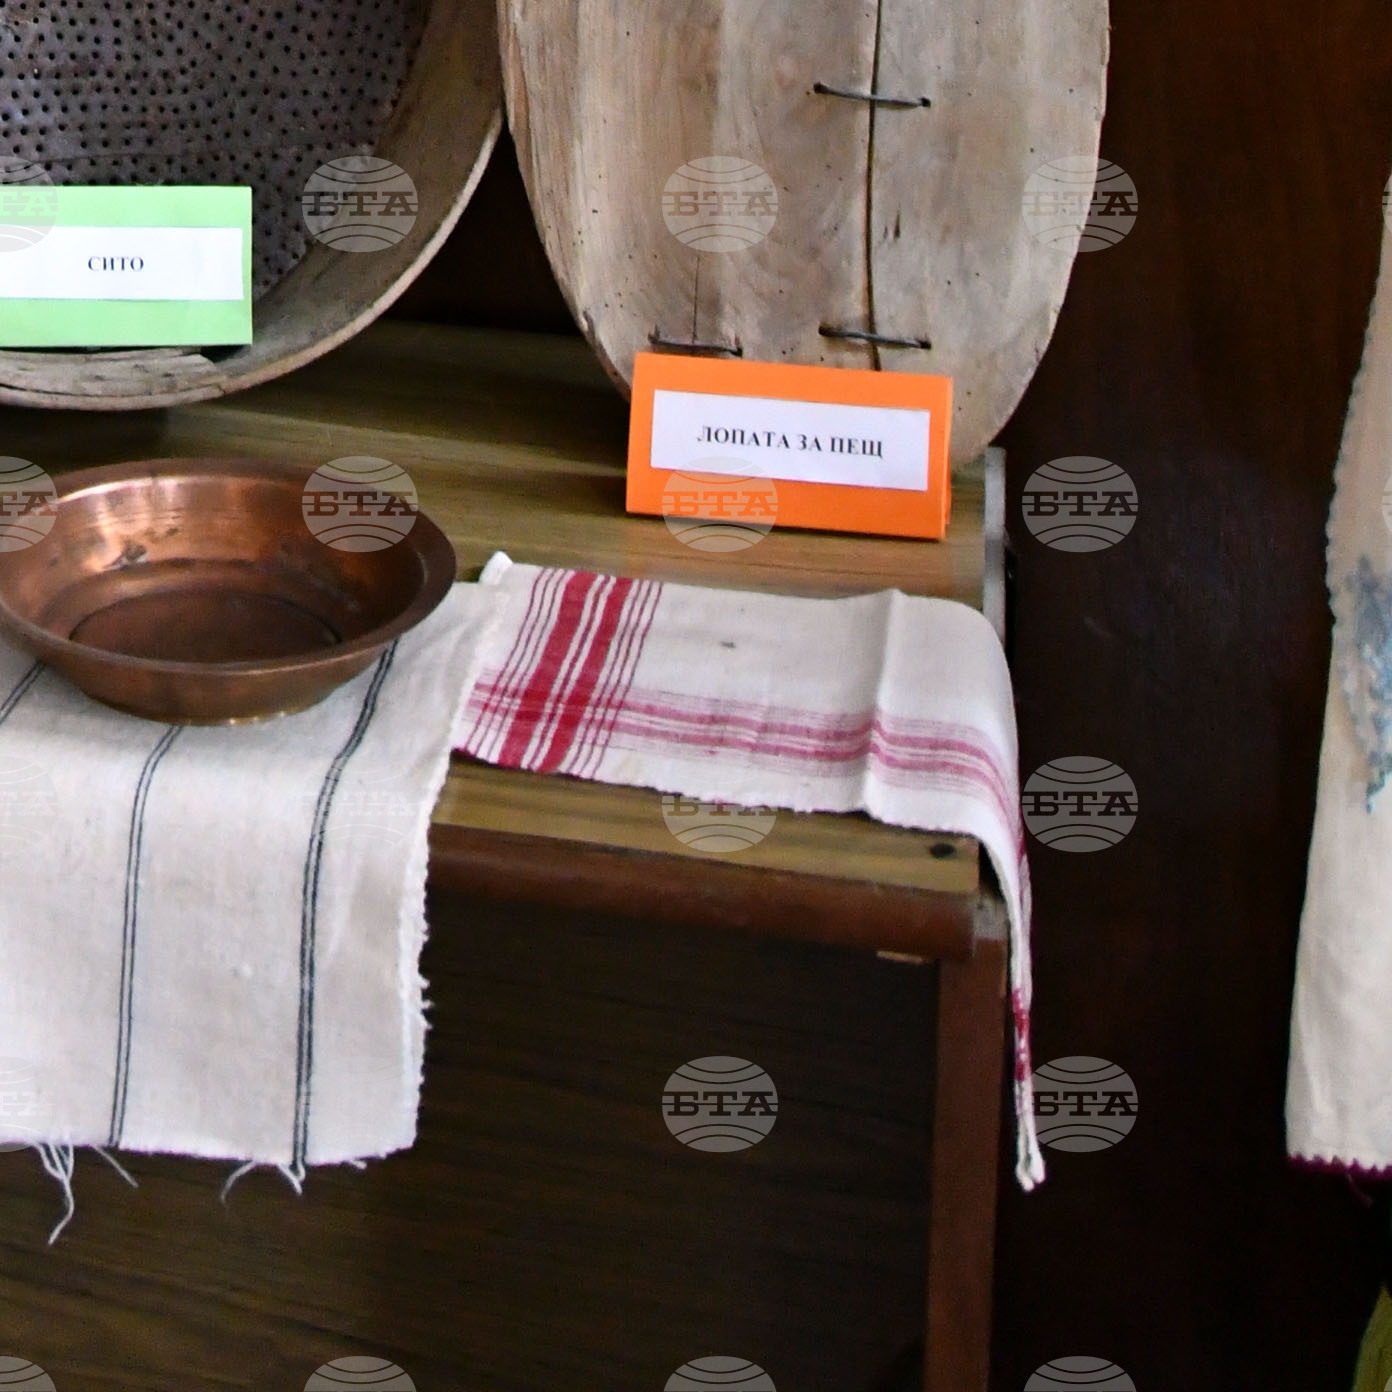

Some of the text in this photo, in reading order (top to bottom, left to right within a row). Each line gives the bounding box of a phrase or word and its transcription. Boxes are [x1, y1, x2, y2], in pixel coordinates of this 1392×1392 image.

[87, 256, 145, 271] СИТО
[697, 426, 883, 459] ЛОПАТА ЗА ПЕЩ
